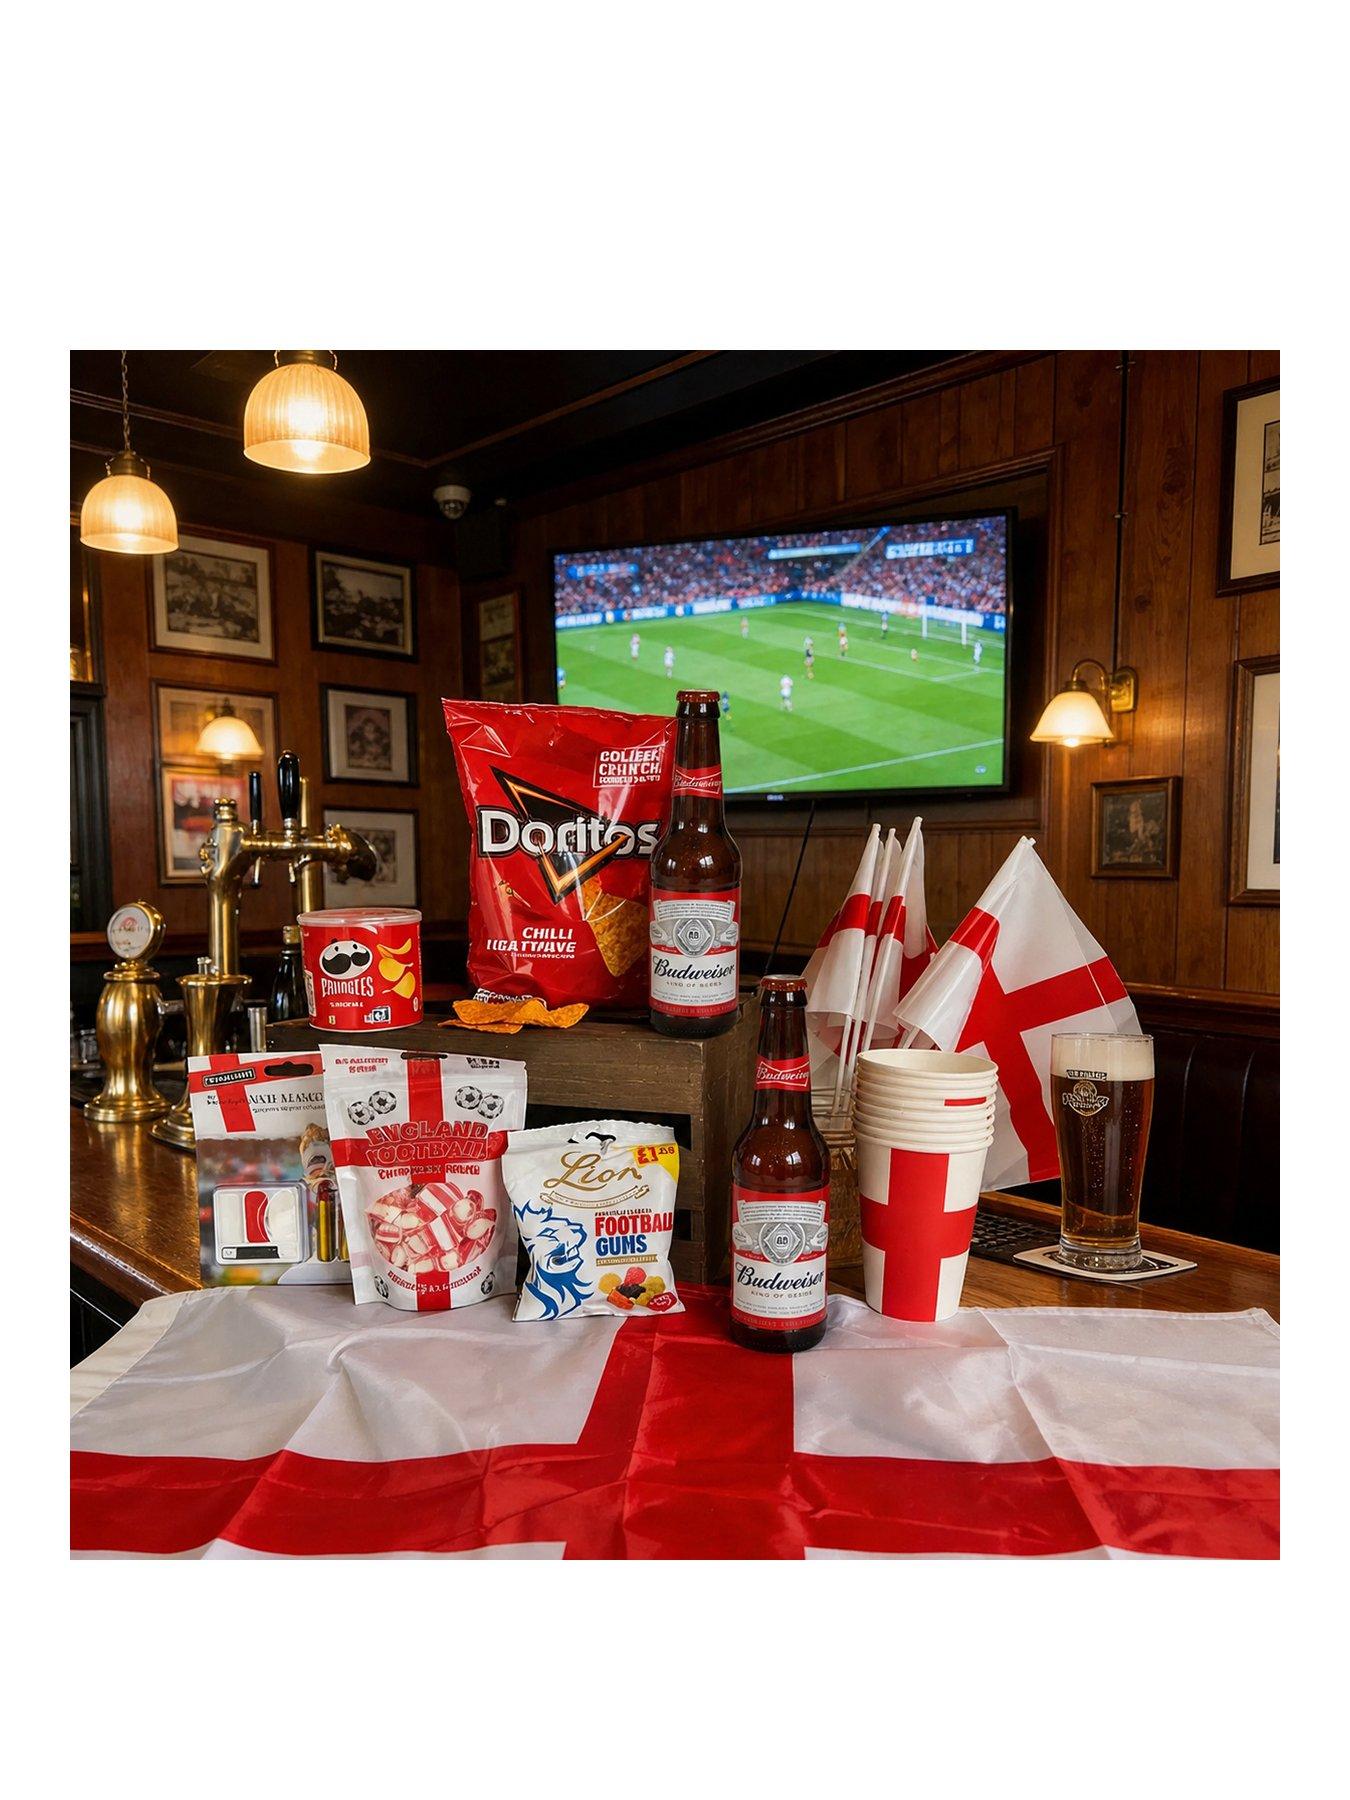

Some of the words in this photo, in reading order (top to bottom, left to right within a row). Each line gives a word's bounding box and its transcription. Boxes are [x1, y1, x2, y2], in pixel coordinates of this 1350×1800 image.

[480, 809, 660, 856] Doritos
[522, 927, 573, 940] CHILLI
[543, 1151, 642, 1192] Lion
[596, 1234, 648, 1257] GUMS
